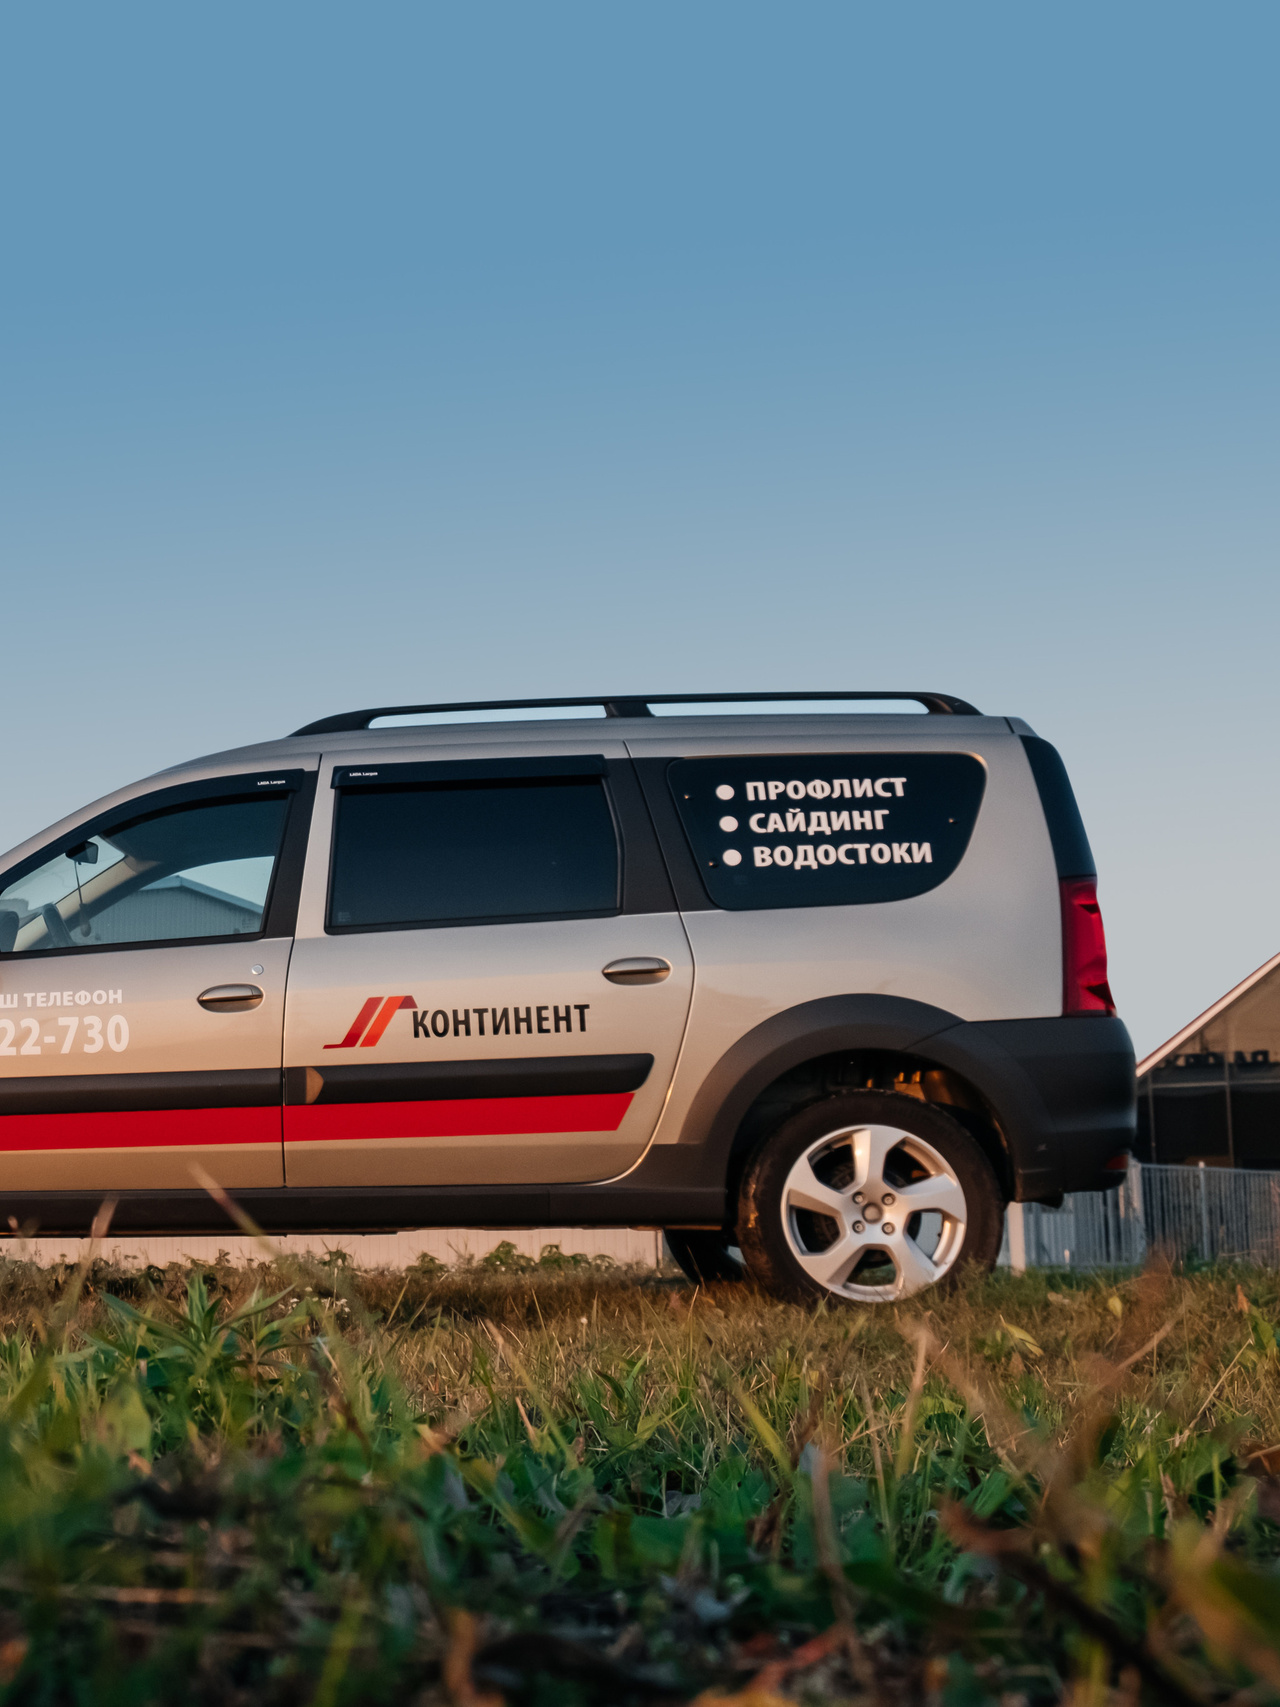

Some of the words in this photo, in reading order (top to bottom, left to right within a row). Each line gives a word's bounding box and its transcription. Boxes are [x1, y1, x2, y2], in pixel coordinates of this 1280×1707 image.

[746, 777, 907, 801] ПРОФЛИСТ
[749, 808, 890, 835] САЙДИНГ
[753, 842, 933, 870] ВОДОСТОКИ
[23, 989, 123, 1008] ТЕЛЕФОН
[412, 1004, 590, 1038] КОНТИНЕНТ
